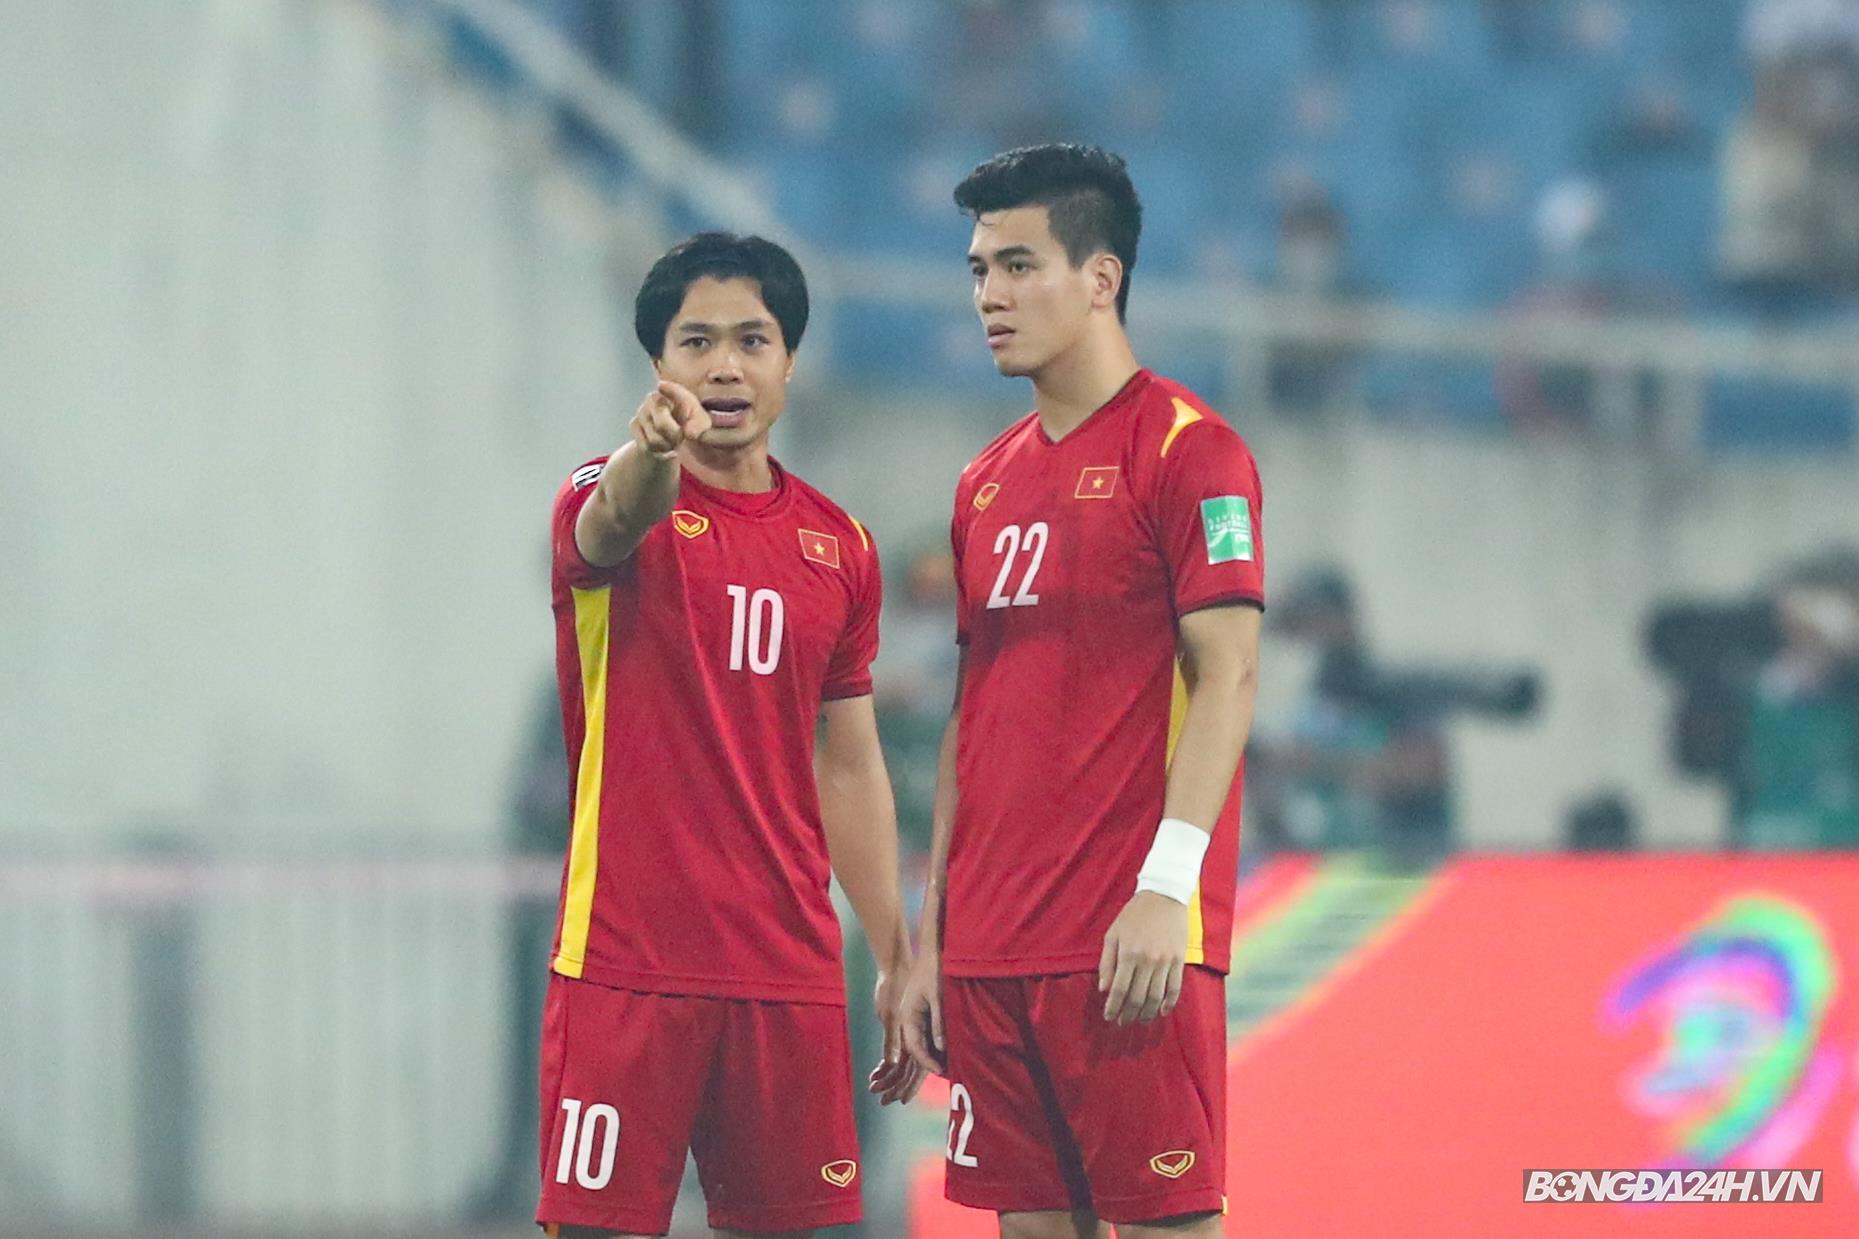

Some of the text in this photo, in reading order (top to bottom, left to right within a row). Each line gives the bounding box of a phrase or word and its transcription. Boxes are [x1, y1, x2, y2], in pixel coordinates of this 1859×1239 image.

[986, 521, 1049, 610] 22
[726, 584, 784, 675] 10
[555, 1097, 620, 1190] 10
